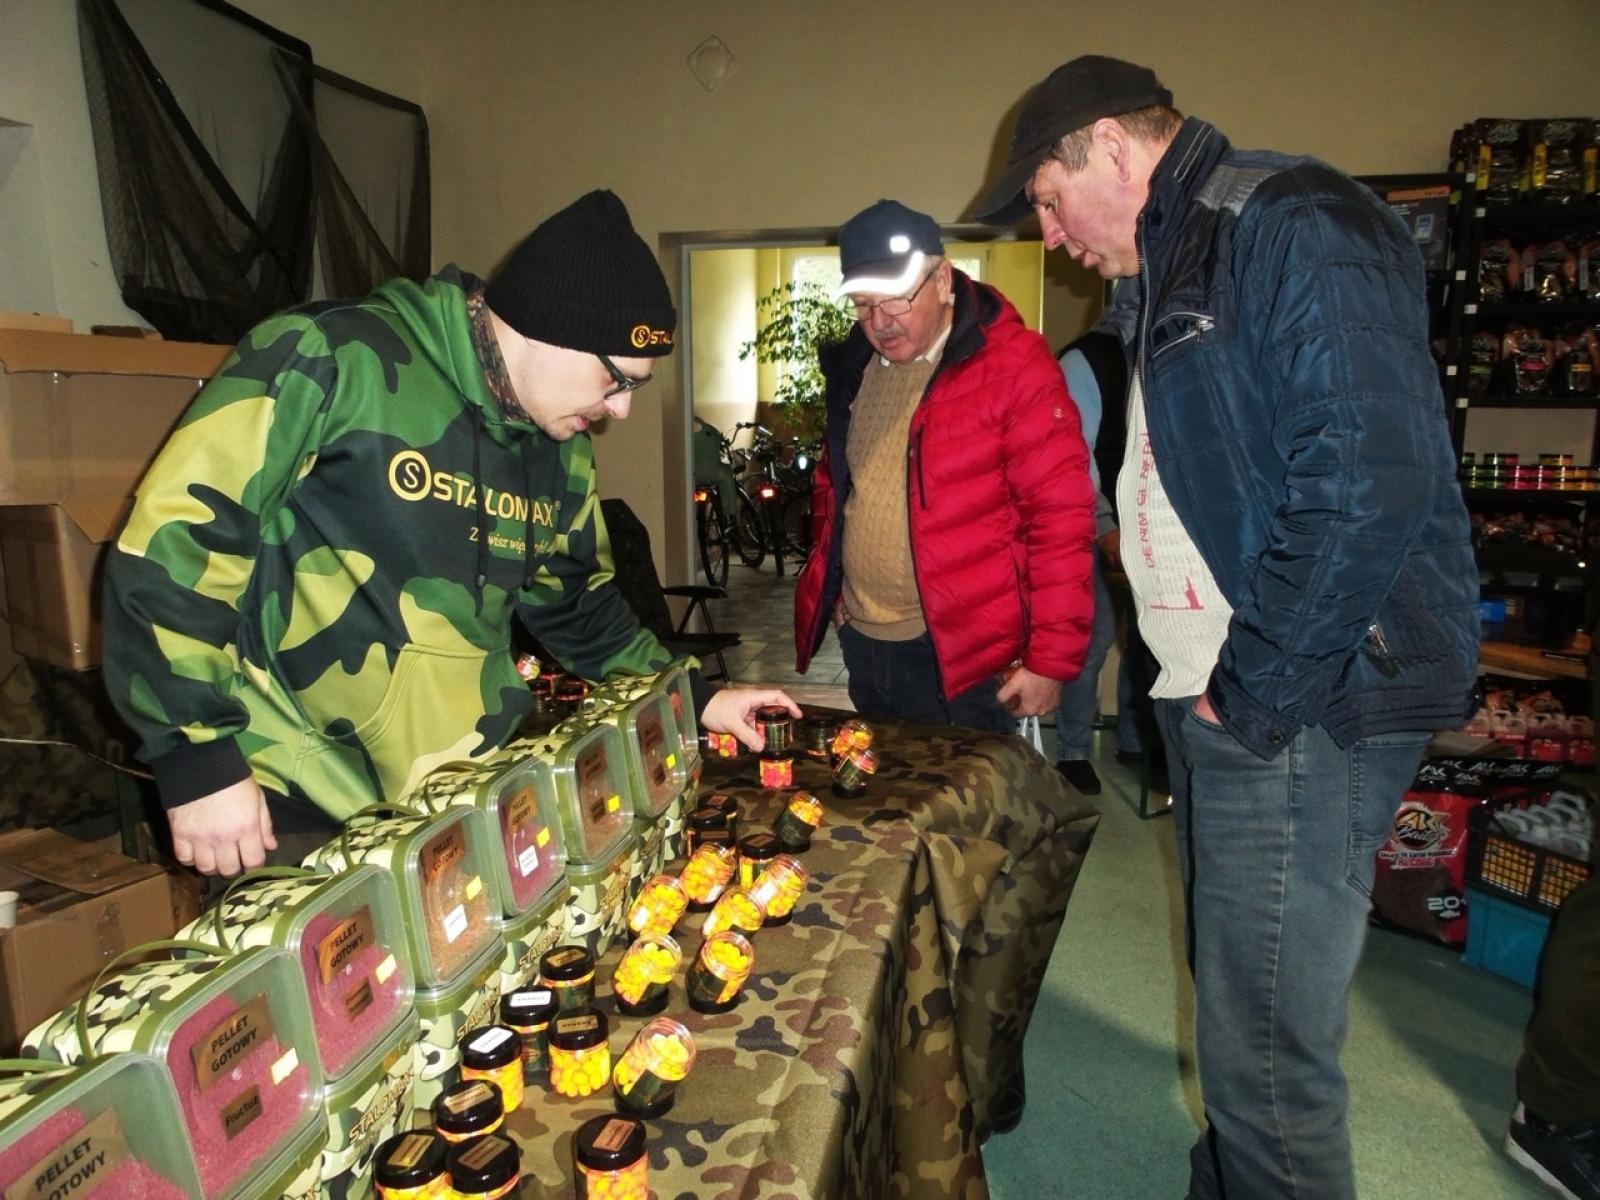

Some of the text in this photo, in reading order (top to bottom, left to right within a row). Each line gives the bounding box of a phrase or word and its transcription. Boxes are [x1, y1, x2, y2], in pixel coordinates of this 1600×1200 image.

[330, 922, 357, 951] PELLET
[331, 934, 364, 968] GOTOWY
[211, 1015, 249, 1052] PELLET
[211, 1028, 257, 1072] GOTOWY
[35, 1137, 91, 1191] PELLET
[50, 1150, 105, 1200] OTOWY
